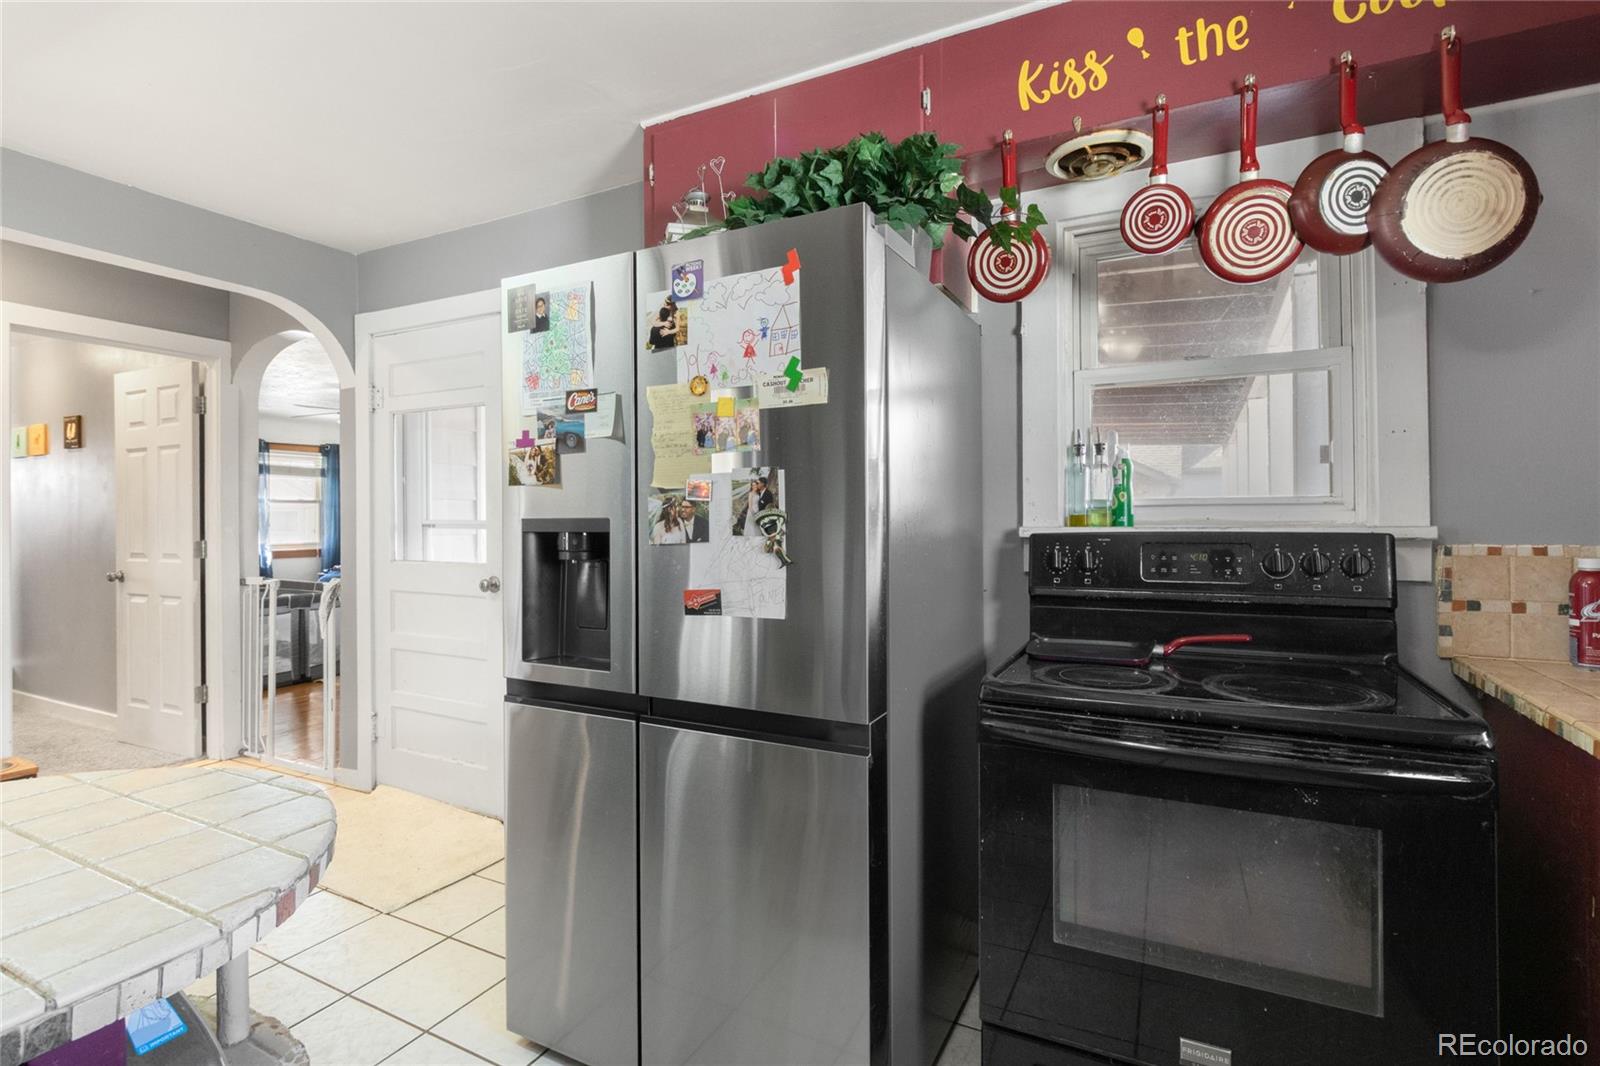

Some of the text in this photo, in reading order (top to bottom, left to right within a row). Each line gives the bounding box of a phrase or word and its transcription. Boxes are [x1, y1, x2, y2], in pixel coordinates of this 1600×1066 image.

[1017, 50, 1114, 111] Kiss
[1175, 15, 1250, 65] the
[1182, 1046, 1230, 1065] FRIGIDAIRE
